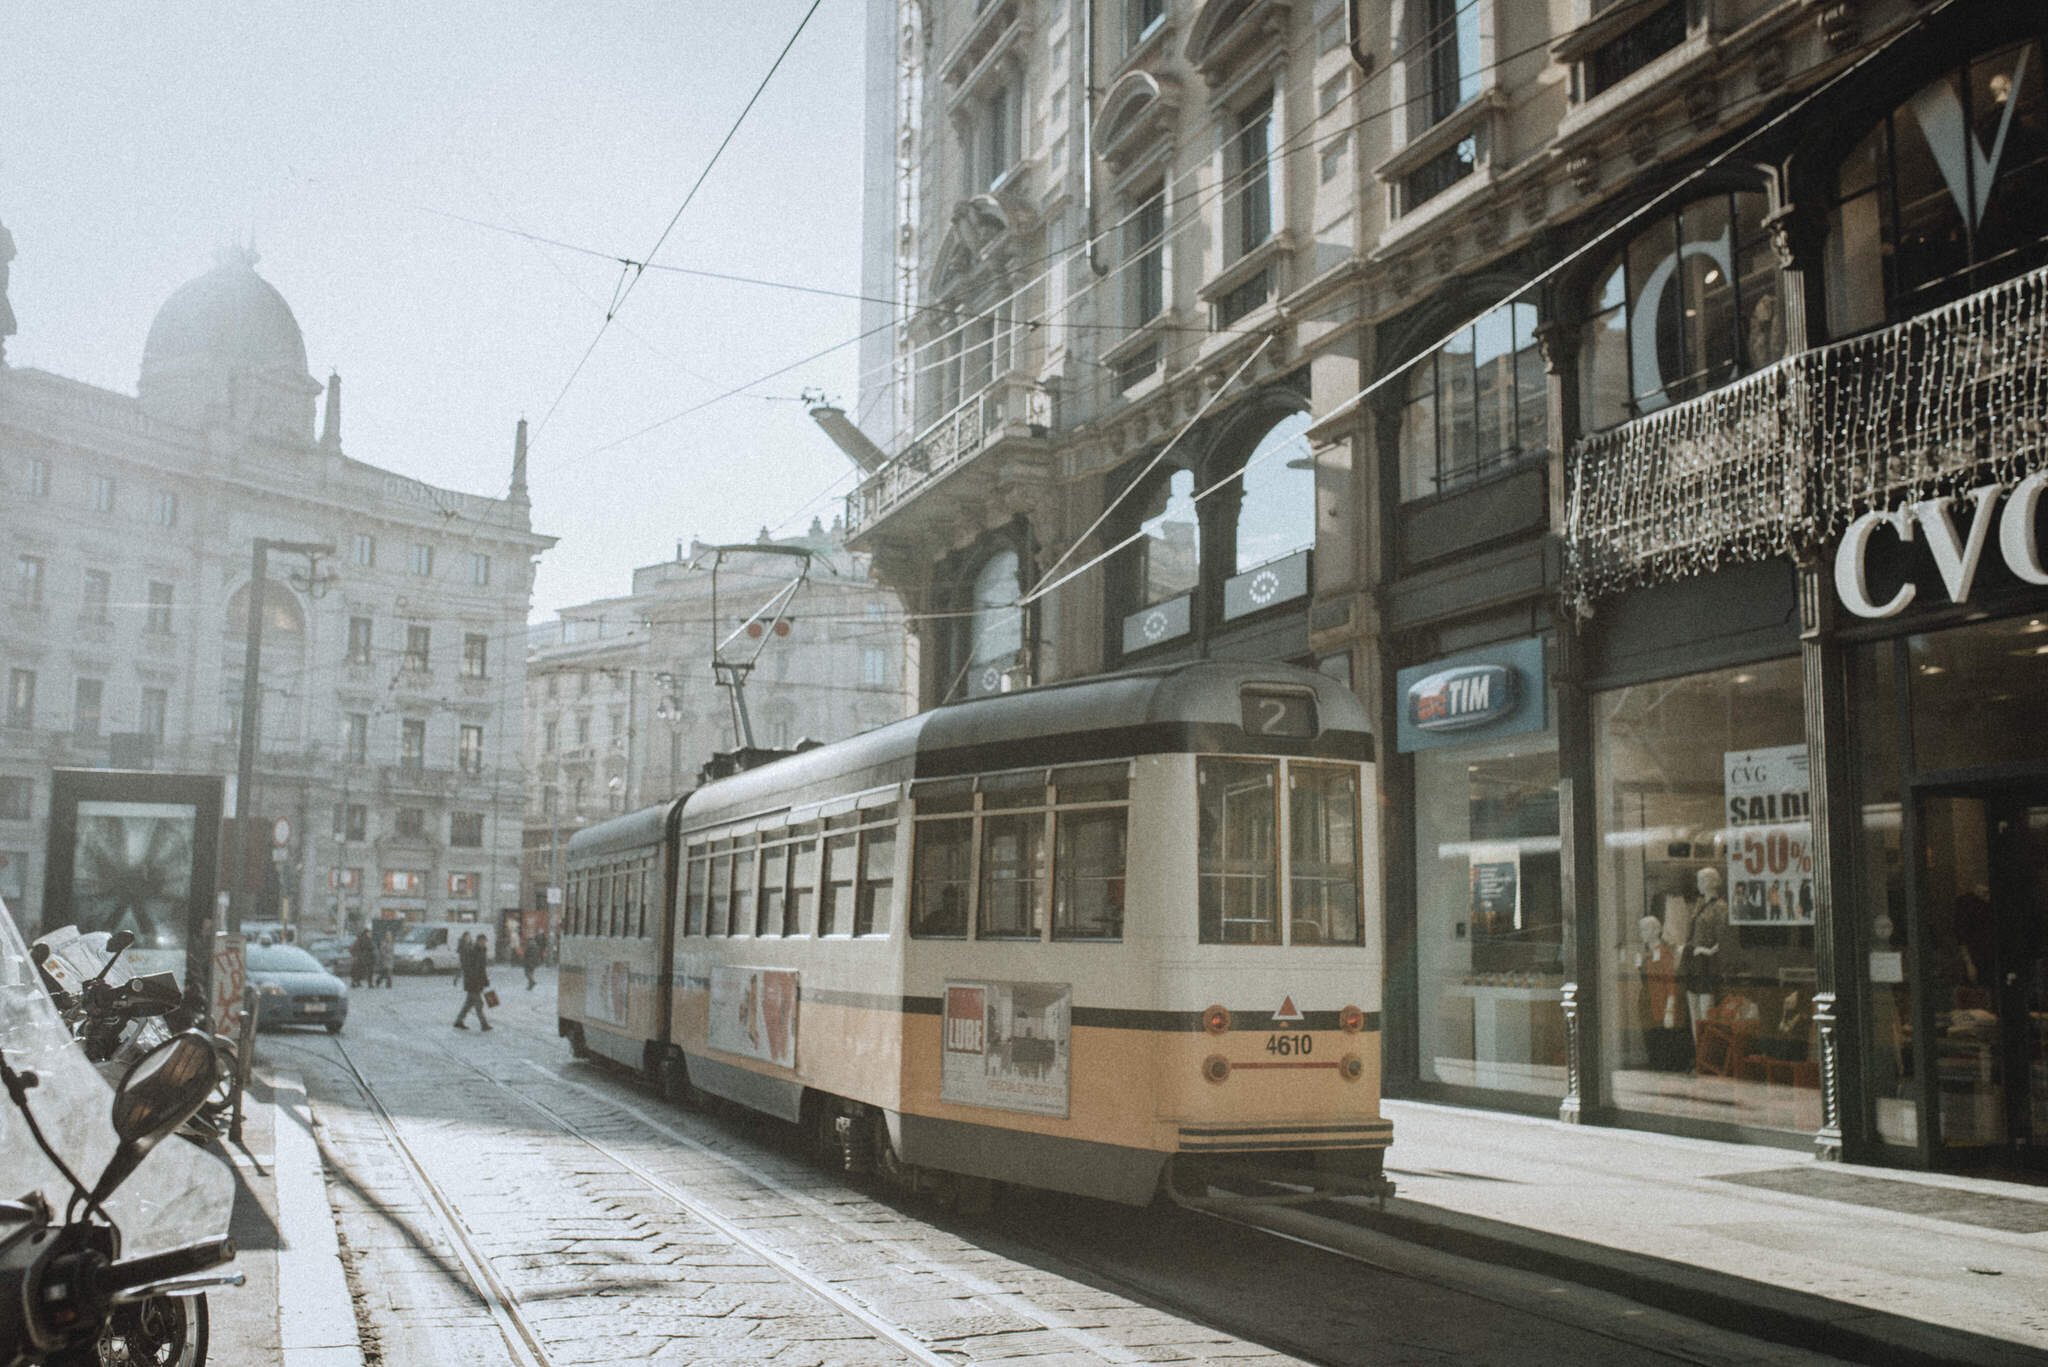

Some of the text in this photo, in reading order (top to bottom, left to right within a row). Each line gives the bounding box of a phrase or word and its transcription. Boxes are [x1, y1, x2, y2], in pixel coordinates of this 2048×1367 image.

[1448, 674, 1490, 716] TIM
[1258, 700, 1287, 735] 2
[1731, 764, 1767, 785] CVG
[1731, 831, 1812, 876] -50%
[948, 1017, 984, 1052] LUBE
[1266, 1034, 1313, 1056] 4610
